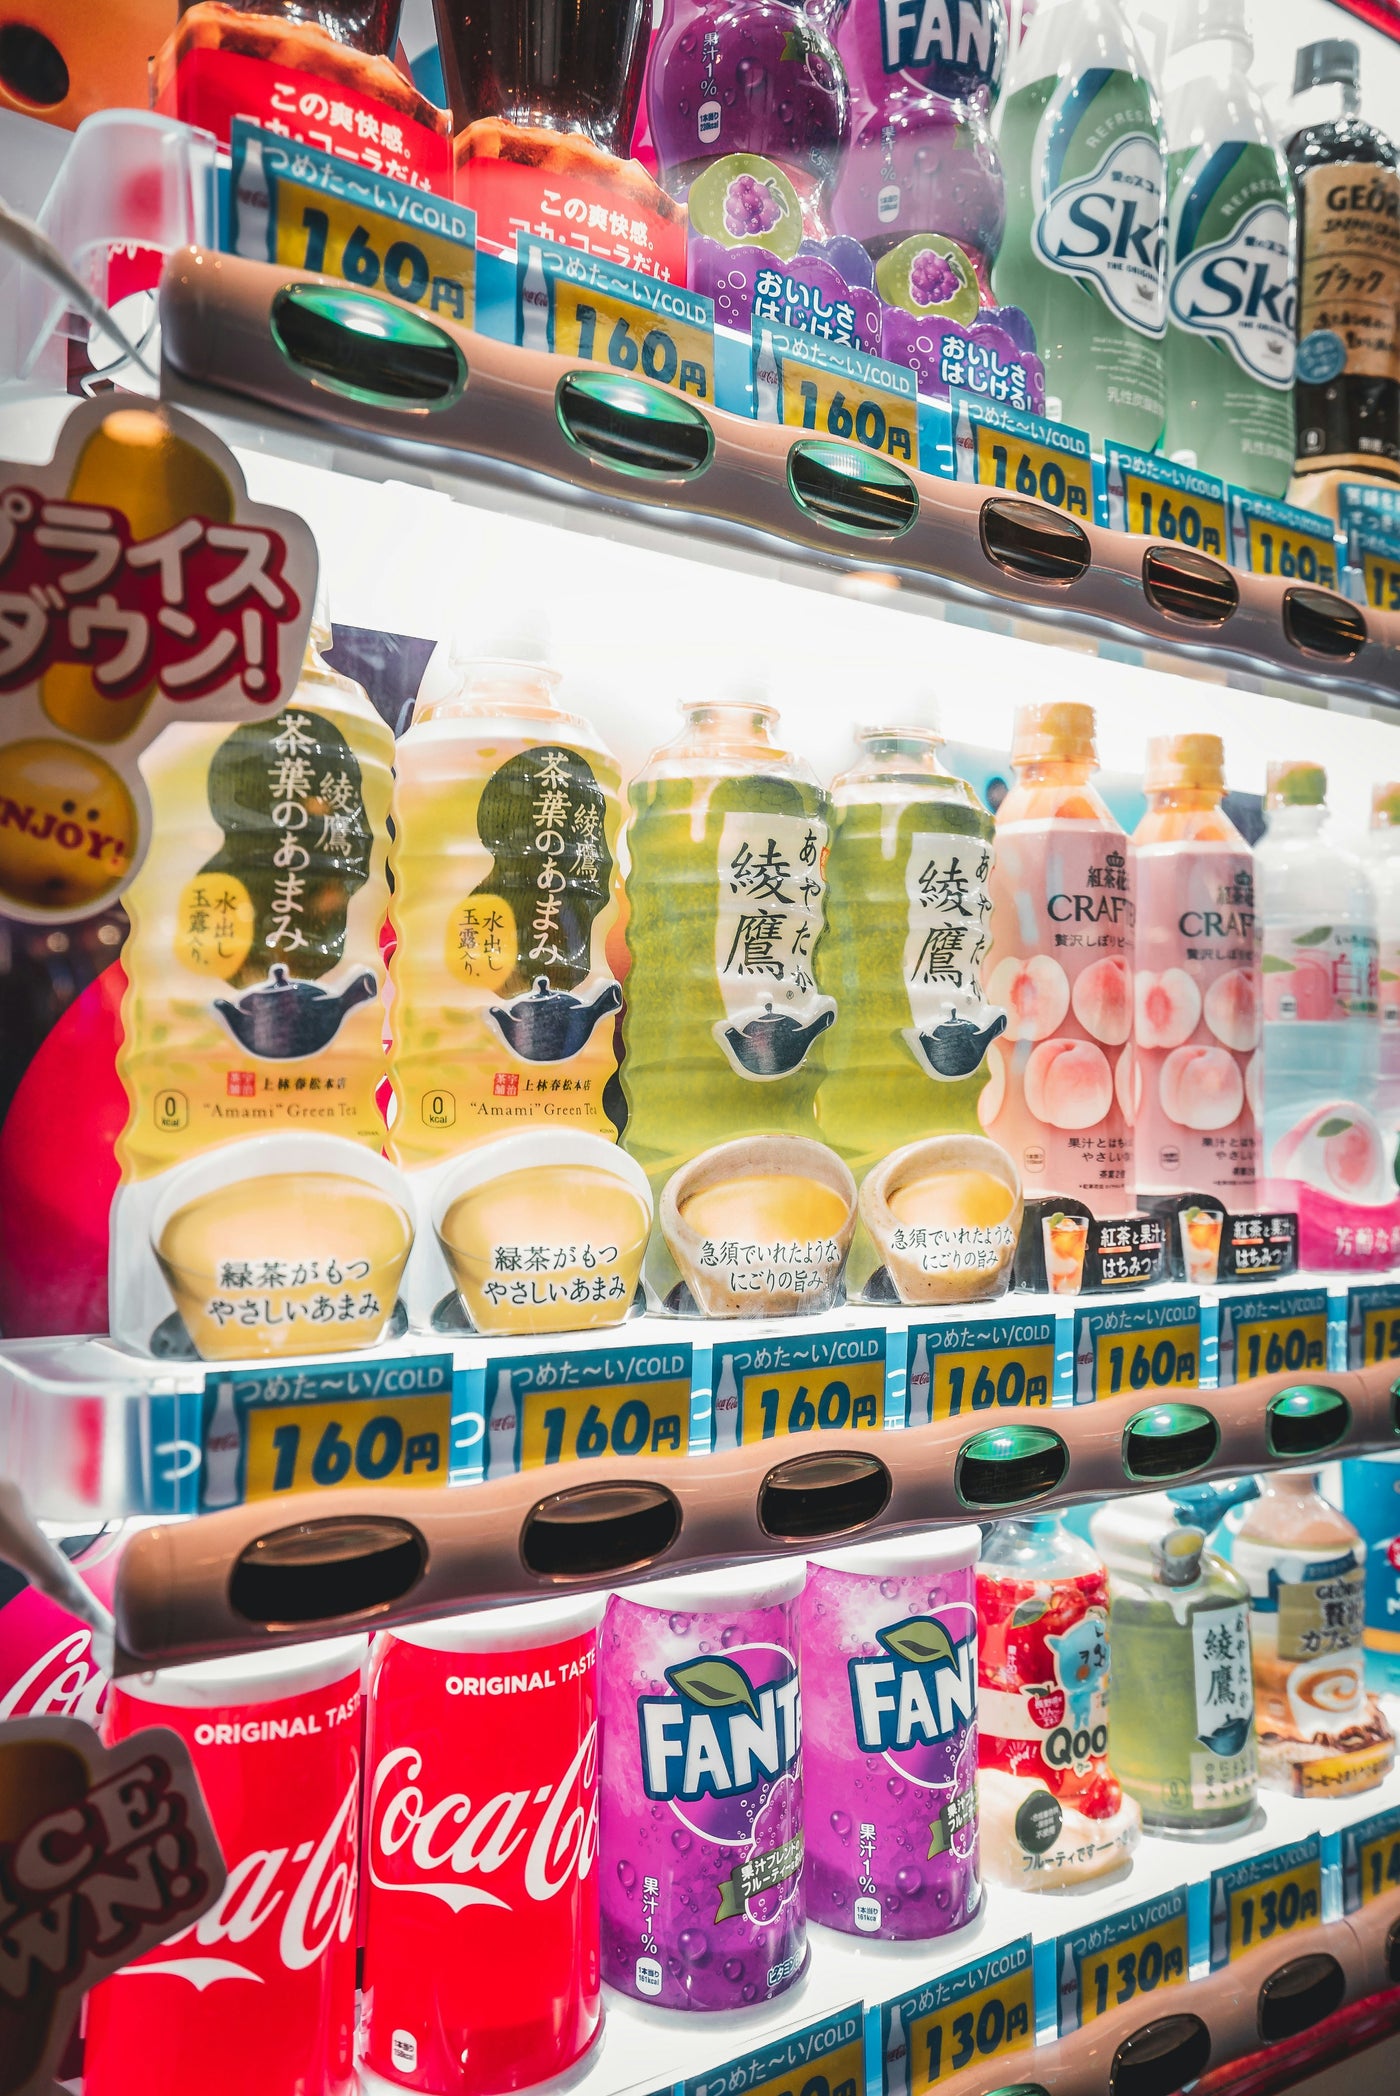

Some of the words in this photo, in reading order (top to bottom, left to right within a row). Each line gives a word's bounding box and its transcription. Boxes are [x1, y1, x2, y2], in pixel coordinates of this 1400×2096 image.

[270, 82, 411, 159] この爽快感。
[541, 189, 654, 251] この爽快感。
[302, 207, 465, 320] 160円
[757, 269, 855, 331] おいしさ
[575, 303, 707, 398] 160円
[942, 335, 1026, 388] おいしさ
[942, 359, 1032, 411] はじける!
[801, 380, 912, 461] 160円
[992, 445, 1087, 516] 160円
[1141, 491, 1221, 556] 160円
[1260, 533, 1334, 591] 160円
[265, 714, 317, 953] 茶葉のあまみ
[314, 771, 356, 857] 綾鷹
[569, 803, 601, 884] 綾鷹
[528, 752, 573, 966] 茶葉のあまみ
[213, 890, 238, 960] 水出し
[723, 838, 796, 982] 綾鷹
[791, 827, 822, 995] あやたか
[910, 856, 974, 989] 綾鷹
[969, 848, 993, 1002] あやたか
[482, 910, 505, 972] 水出し
[165, 1096, 176, 1117] 0
[263, 1076, 347, 1091] 上林春松本店
[286, 1103, 335, 1118] Green
[340, 1103, 357, 1117] Tea
[432, 1096, 444, 1115] 0
[522, 1078, 592, 1092] 上林春松本店
[544, 1103, 582, 1116] Green
[584, 1102, 597, 1115] Tea
[161, 1117, 180, 1127] kcal
[429, 1114, 448, 1124] kcal
[493, 1243, 619, 1273] 緑茶がもつ
[699, 1239, 841, 1267] 急須でいれたような
[891, 1225, 1016, 1250] 急須でいれたような
[921, 1250, 999, 1272] にごりの旨み
[219, 1257, 371, 1289] 緑茶がもつ
[483, 1276, 626, 1304] やさしいあまみ
[730, 1270, 825, 1294] にごりの旨み
[208, 1292, 381, 1327] やさしいあまみ
[1109, 1340, 1195, 1394] 160円
[1247, 1328, 1324, 1379] 160円
[760, 1380, 877, 1440] 160円
[948, 1361, 1048, 1417] 160円
[272, 1415, 440, 1492] 160円
[543, 1399, 681, 1464] 160円
[445, 1670, 556, 1696] ORIGINAL
[559, 1648, 597, 1683] TASTE
[1203, 1623, 1236, 1707] 綾鷹
[193, 1714, 322, 1746] ORIGINAL
[858, 1823, 877, 1894] 果汁1%
[640, 1876, 659, 1954] 果汁1%
[856, 1906, 879, 1915] 1本当り
[1241, 1882, 1318, 1947] 130円
[638, 1966, 660, 1977] 1本当り
[1094, 1941, 1183, 2017] 130円
[926, 1999, 1028, 2084] 130円
